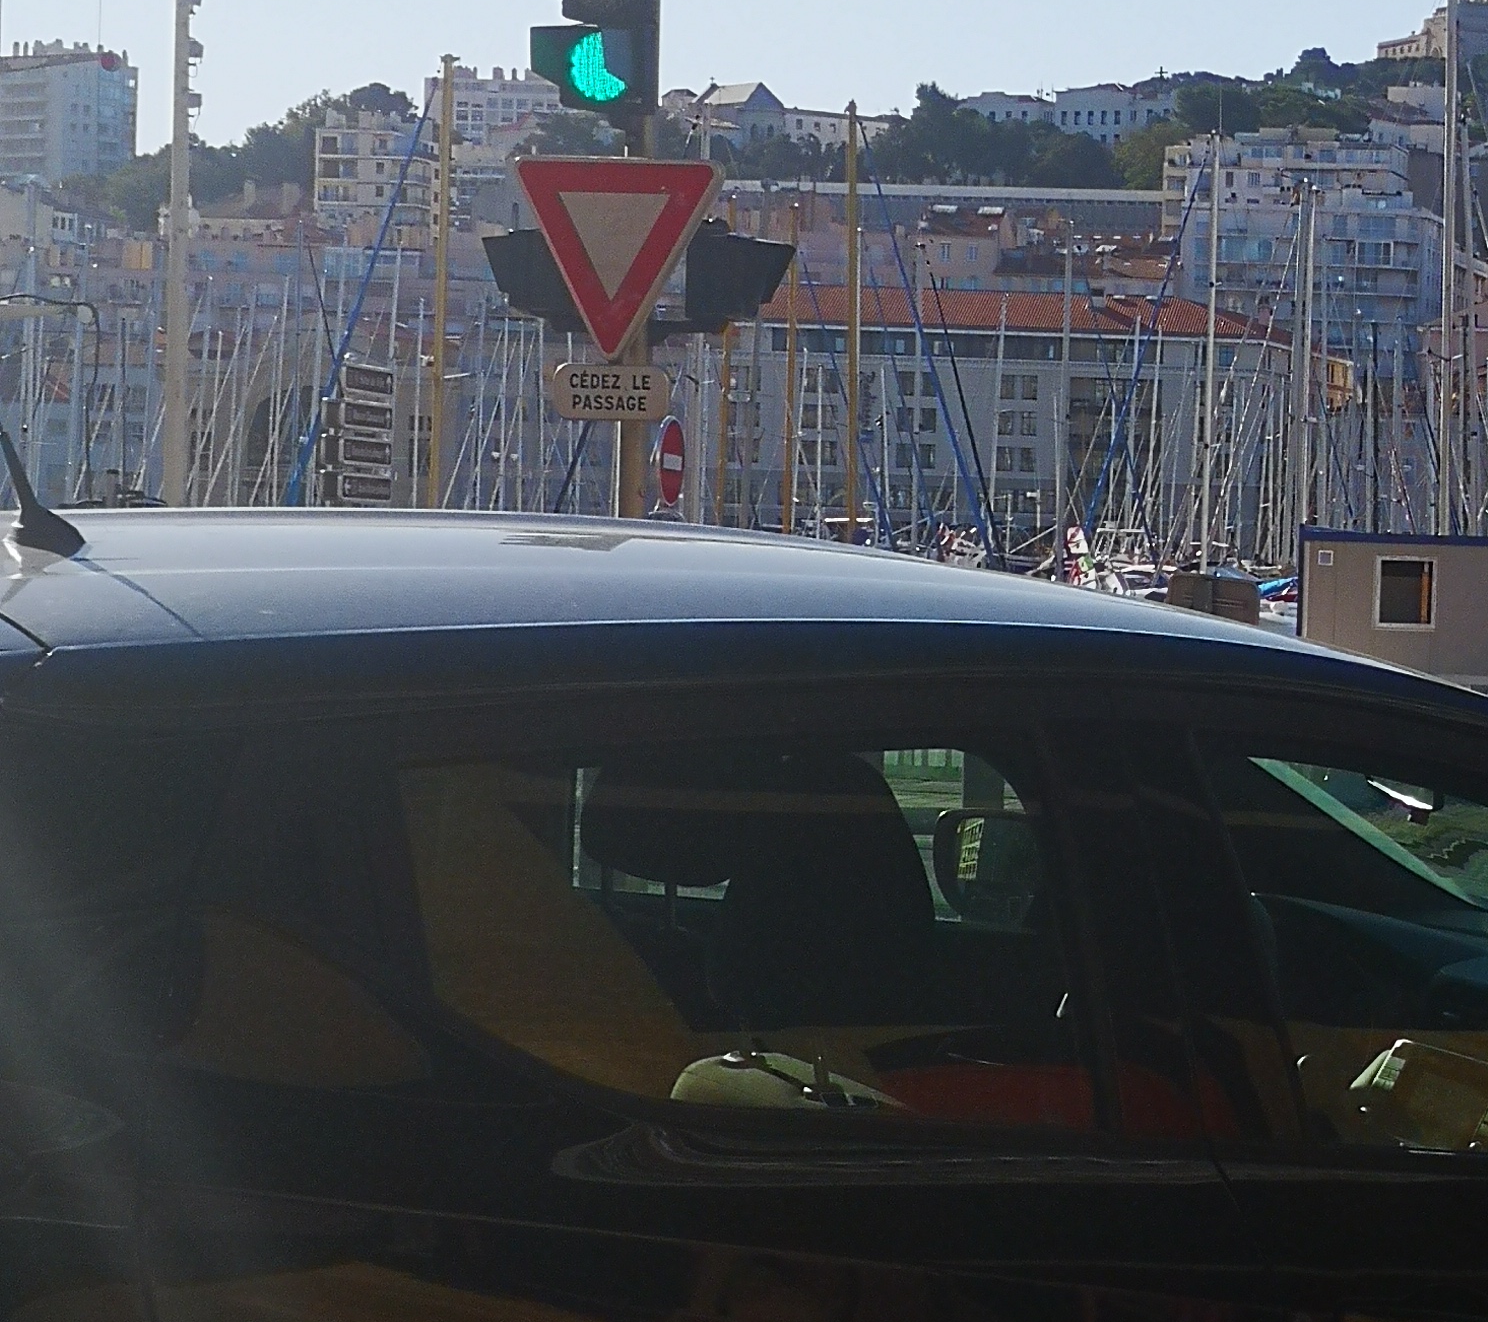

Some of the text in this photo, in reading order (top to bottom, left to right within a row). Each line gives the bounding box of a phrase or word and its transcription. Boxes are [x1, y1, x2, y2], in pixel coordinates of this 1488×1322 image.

[570, 370, 651, 390] CÉDEZ LE
[572, 394, 647, 412] PASSAGE
